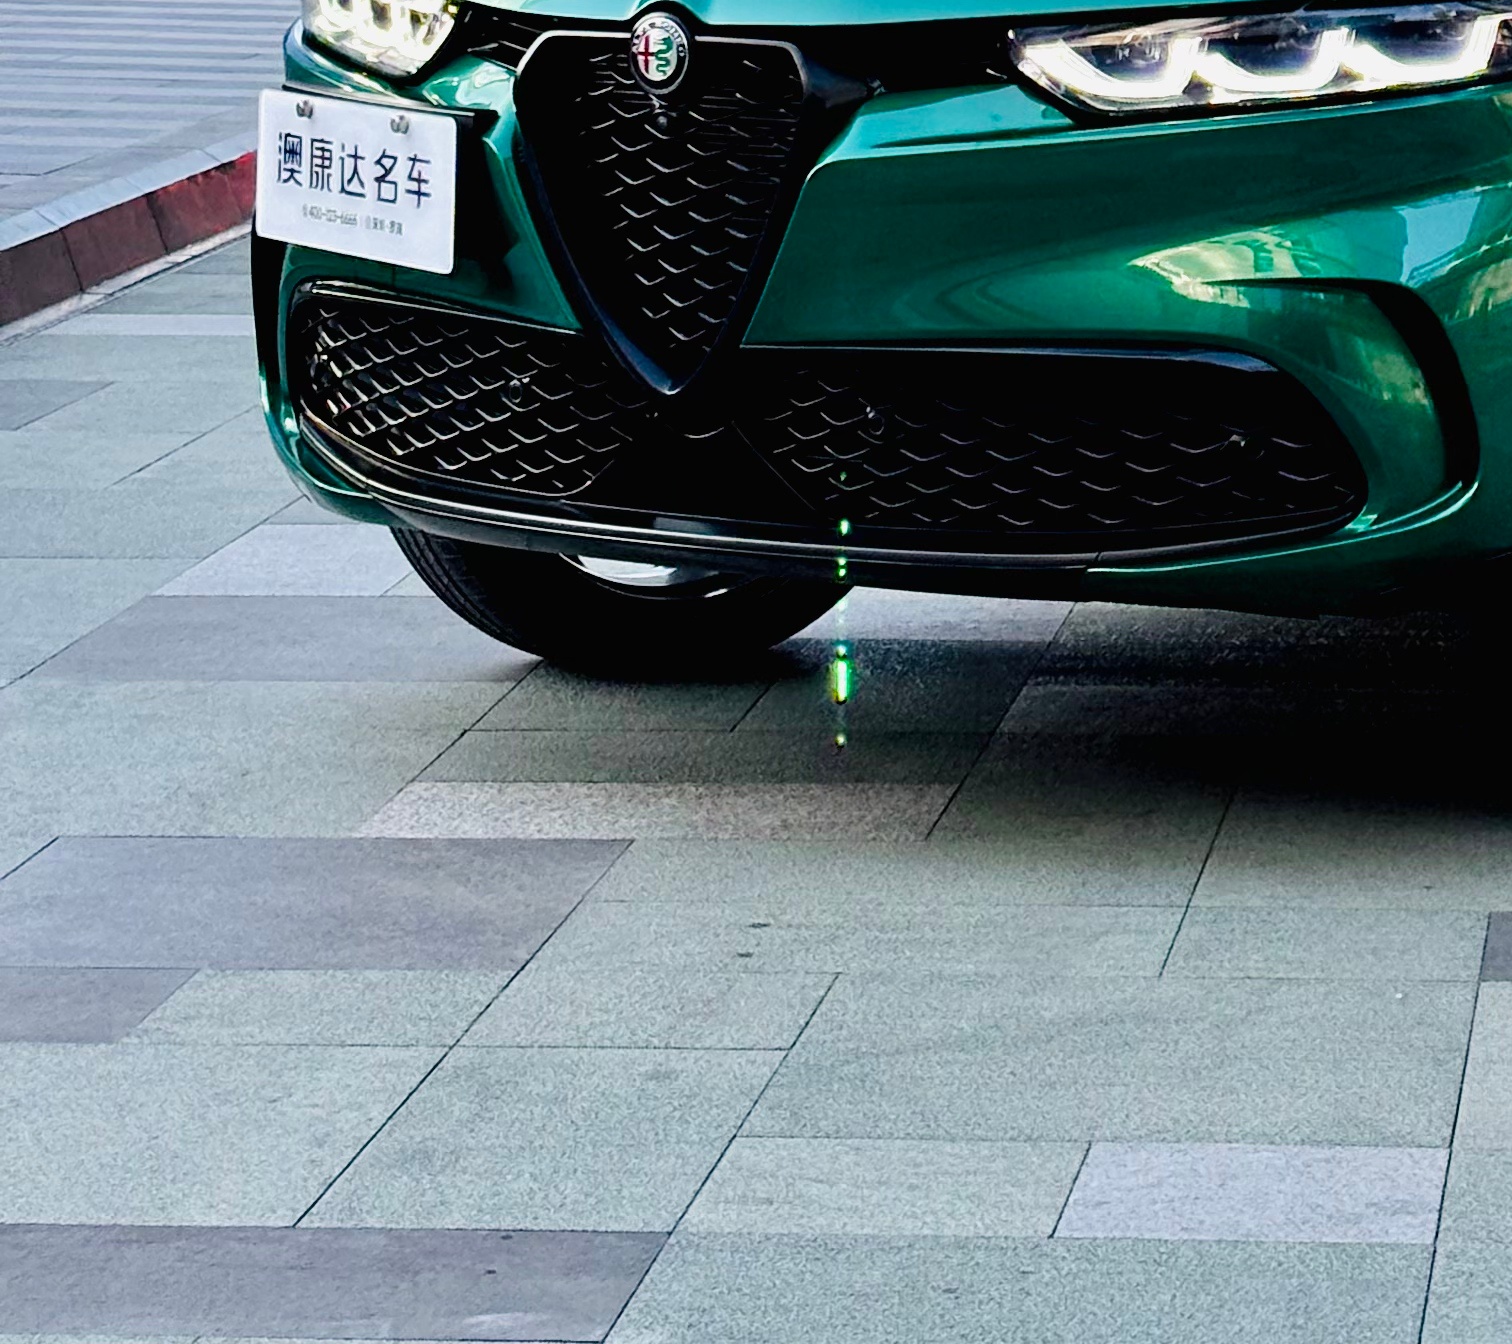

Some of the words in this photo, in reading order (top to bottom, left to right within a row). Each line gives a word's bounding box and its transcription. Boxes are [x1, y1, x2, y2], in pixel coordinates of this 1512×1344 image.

[276, 131, 432, 209] 澳康达名车
